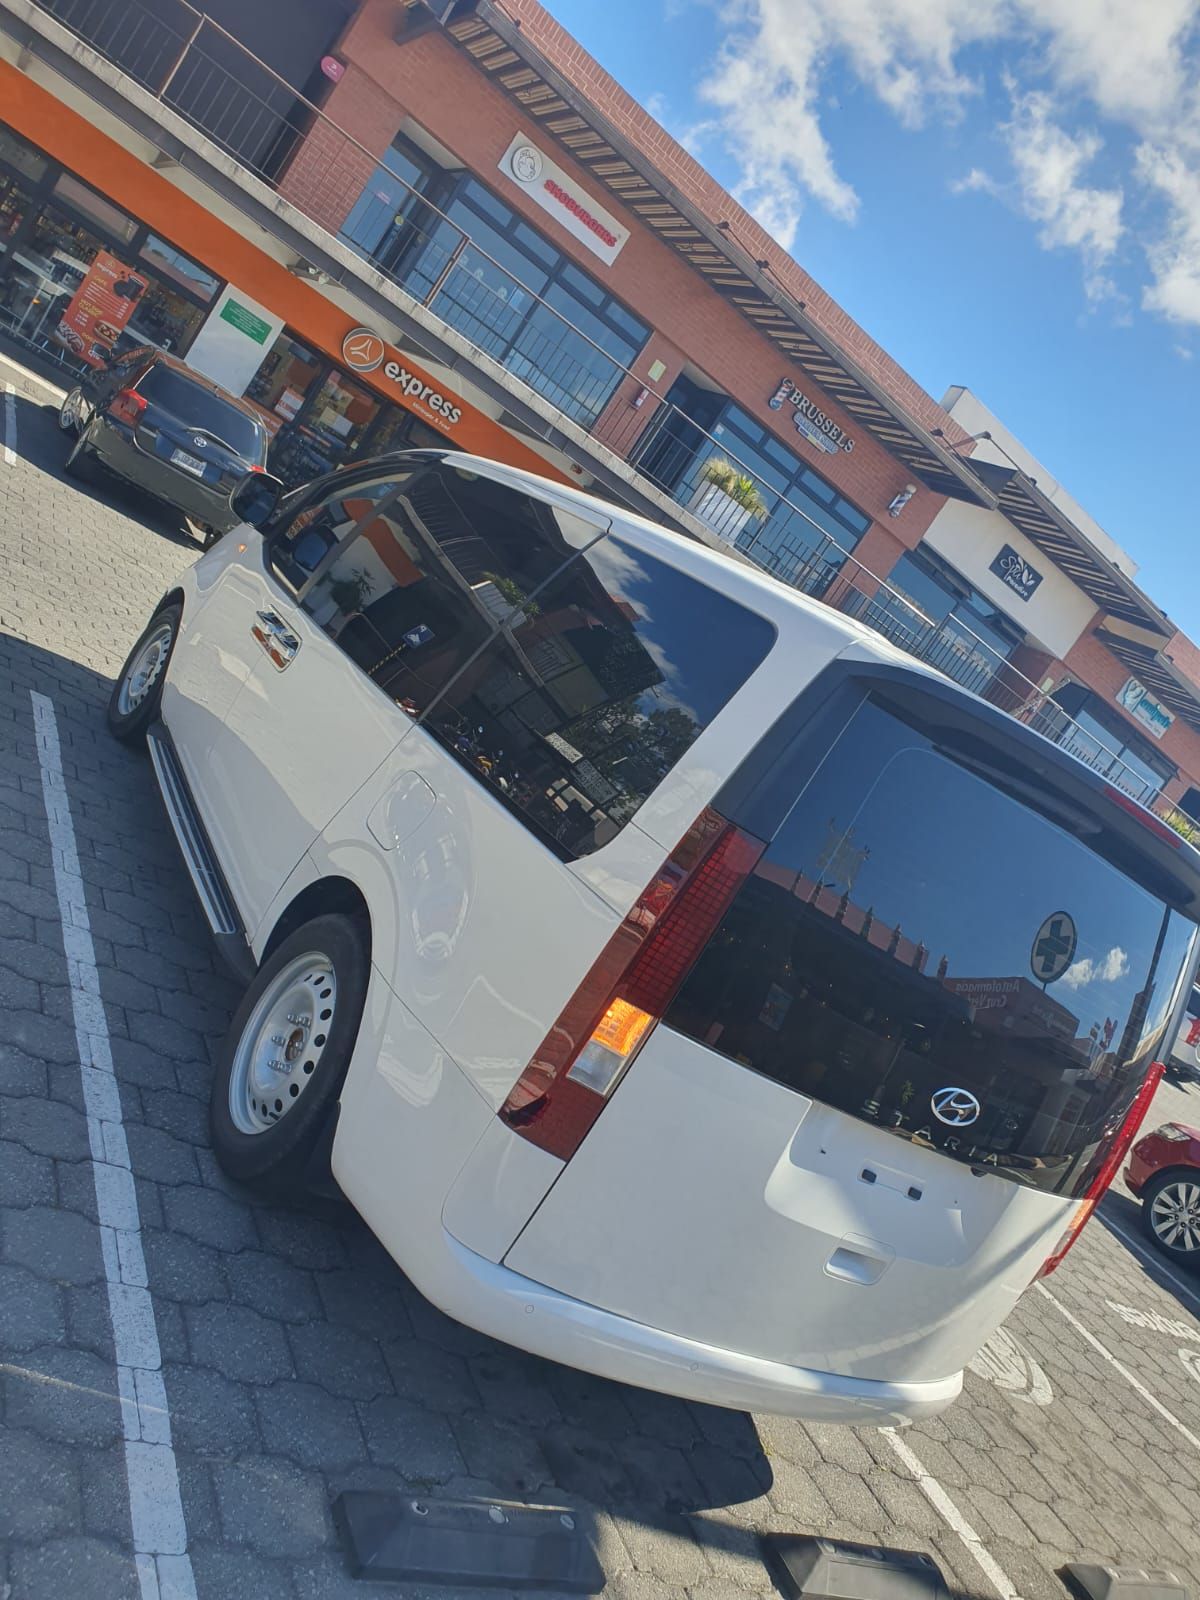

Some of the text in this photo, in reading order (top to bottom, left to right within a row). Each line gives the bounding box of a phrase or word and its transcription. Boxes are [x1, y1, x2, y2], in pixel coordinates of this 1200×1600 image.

[384, 361, 461, 423] express
[789, 388, 855, 453] BRUSSELS
[1000, 556, 1021, 580] Spa
